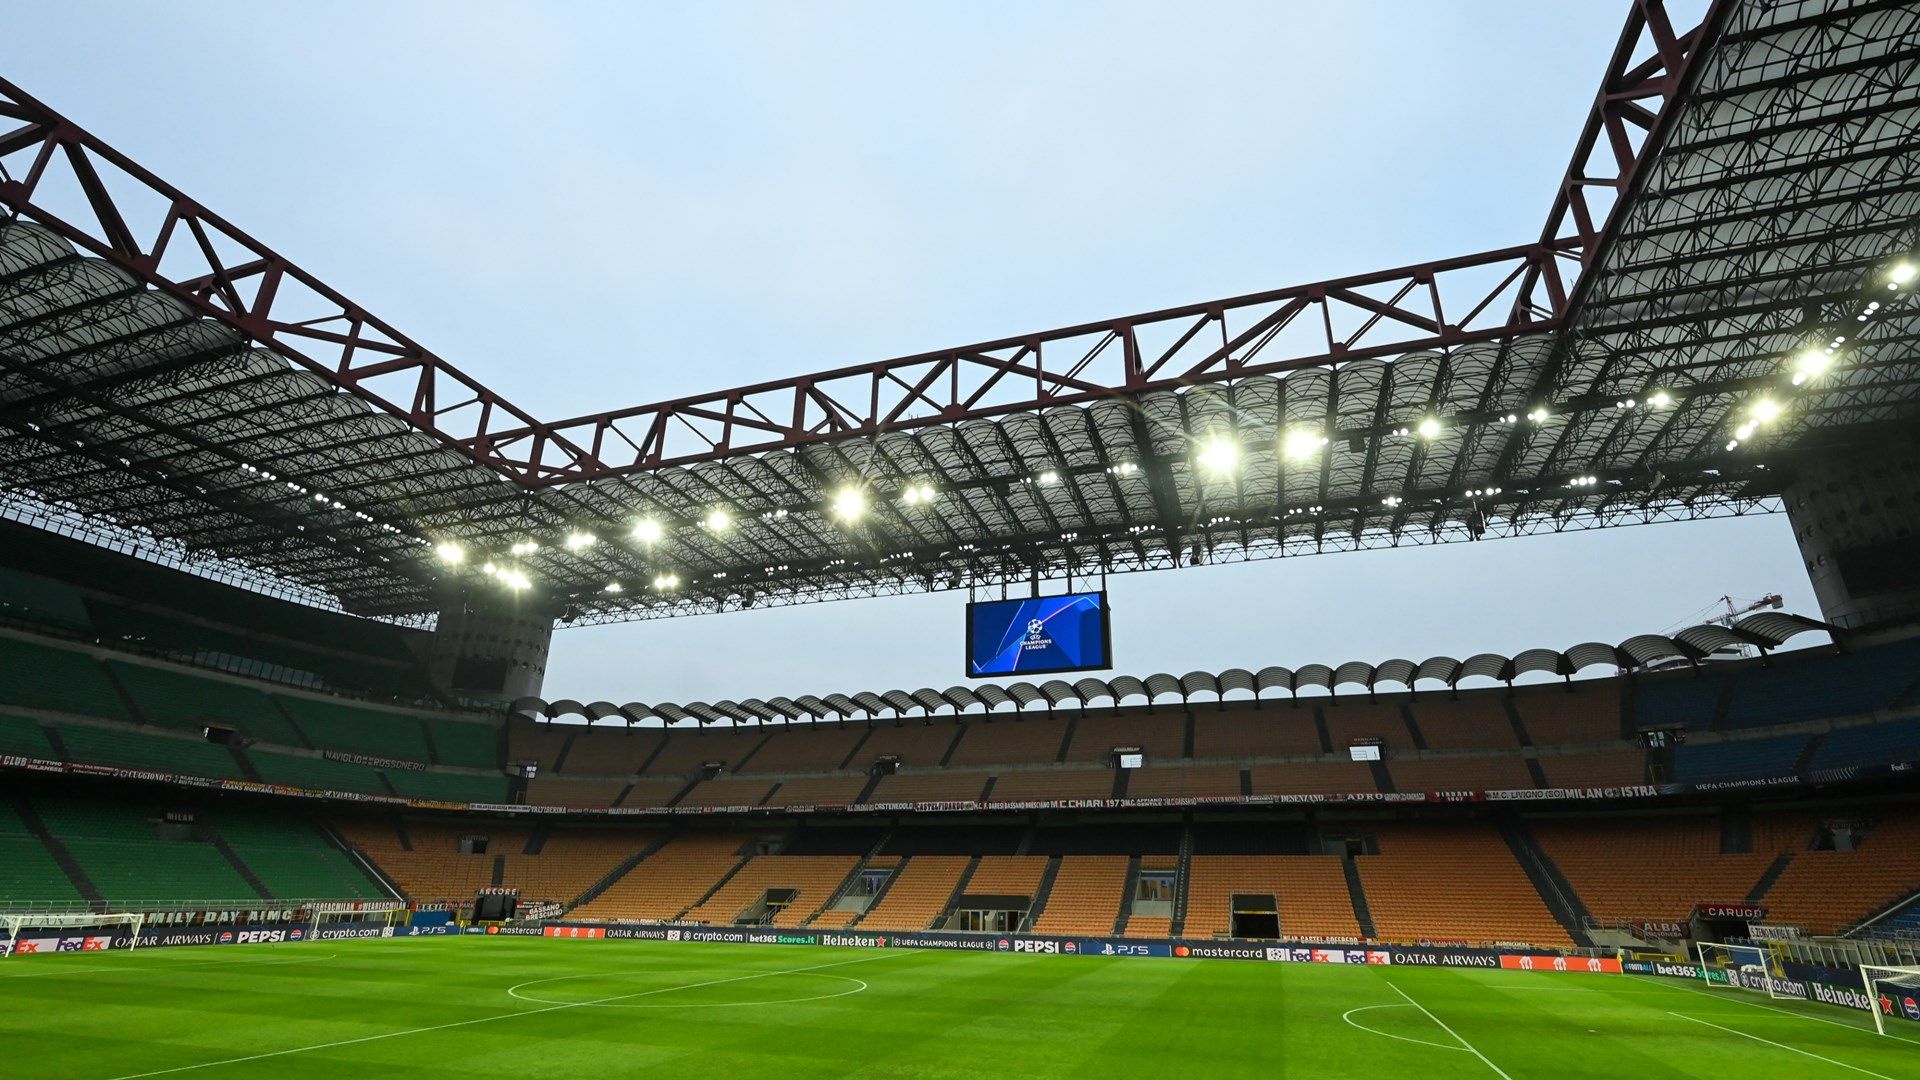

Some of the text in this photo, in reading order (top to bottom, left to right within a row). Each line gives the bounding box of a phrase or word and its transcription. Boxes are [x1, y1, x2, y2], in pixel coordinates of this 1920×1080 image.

[3, 755, 28, 766] CLUB
[325, 750, 425, 772] NAVIGLIO ROSSONERO
[1718, 779, 1766, 789] CHAMPIONS
[1768, 776, 1799, 785] LEAGUE
[243, 785, 273, 794] MONTANA
[1565, 786, 1657, 799] MILAN ISTRA
[525, 909, 563, 920] BRESCIANO
[529, 903, 560, 914] BASSANO
[204, 911, 240, 922] DAY
[322, 927, 379, 939] crypto.com
[500, 926, 542, 935] mastercard
[1644, 922, 1681, 932] ALBA
[237, 930, 286, 943] PEPSI
[607, 930, 665, 938] QATAR AIRWAYS
[693, 931, 742, 943] crypto.com
[0, 936, 104, 954] edEx FedEx
[115, 934, 211, 947] QATAR AIRWAYS
[823, 934, 875, 947] Heineken
[920, 940, 957, 948] CHAMPIONS
[1014, 940, 1060, 953] PEPSI
[1117, 945, 1149, 955] PS5
[1192, 946, 1263, 958] mastercard
[1290, 948, 1385, 964] FedEx FedEx
[1395, 953, 1496, 967] QATAR AIRWAYS
[1656, 963, 1696, 978] bet365
[1812, 982, 1871, 1010] Heineke
